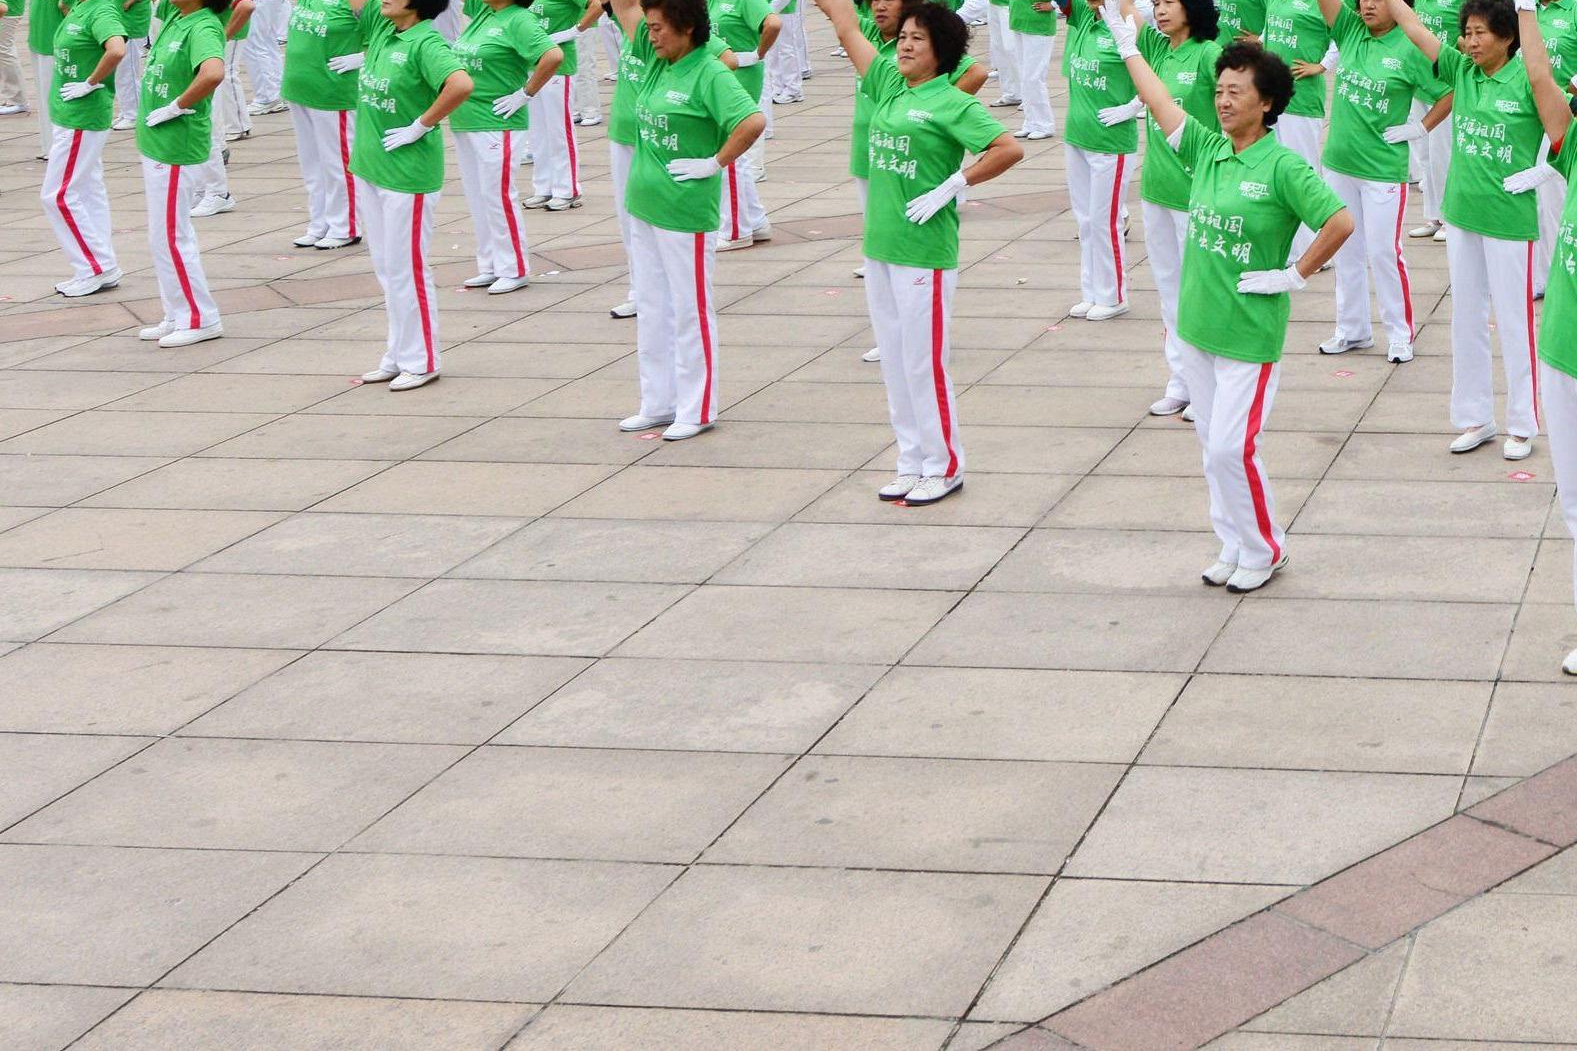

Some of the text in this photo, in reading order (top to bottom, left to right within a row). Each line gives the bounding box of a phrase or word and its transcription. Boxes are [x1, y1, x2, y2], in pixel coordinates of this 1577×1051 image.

[1335, 67, 1387, 95] 祝福祖国
[1337, 82, 1390, 114] 舞出文明
[1456, 132, 1513, 164] 舞出文明
